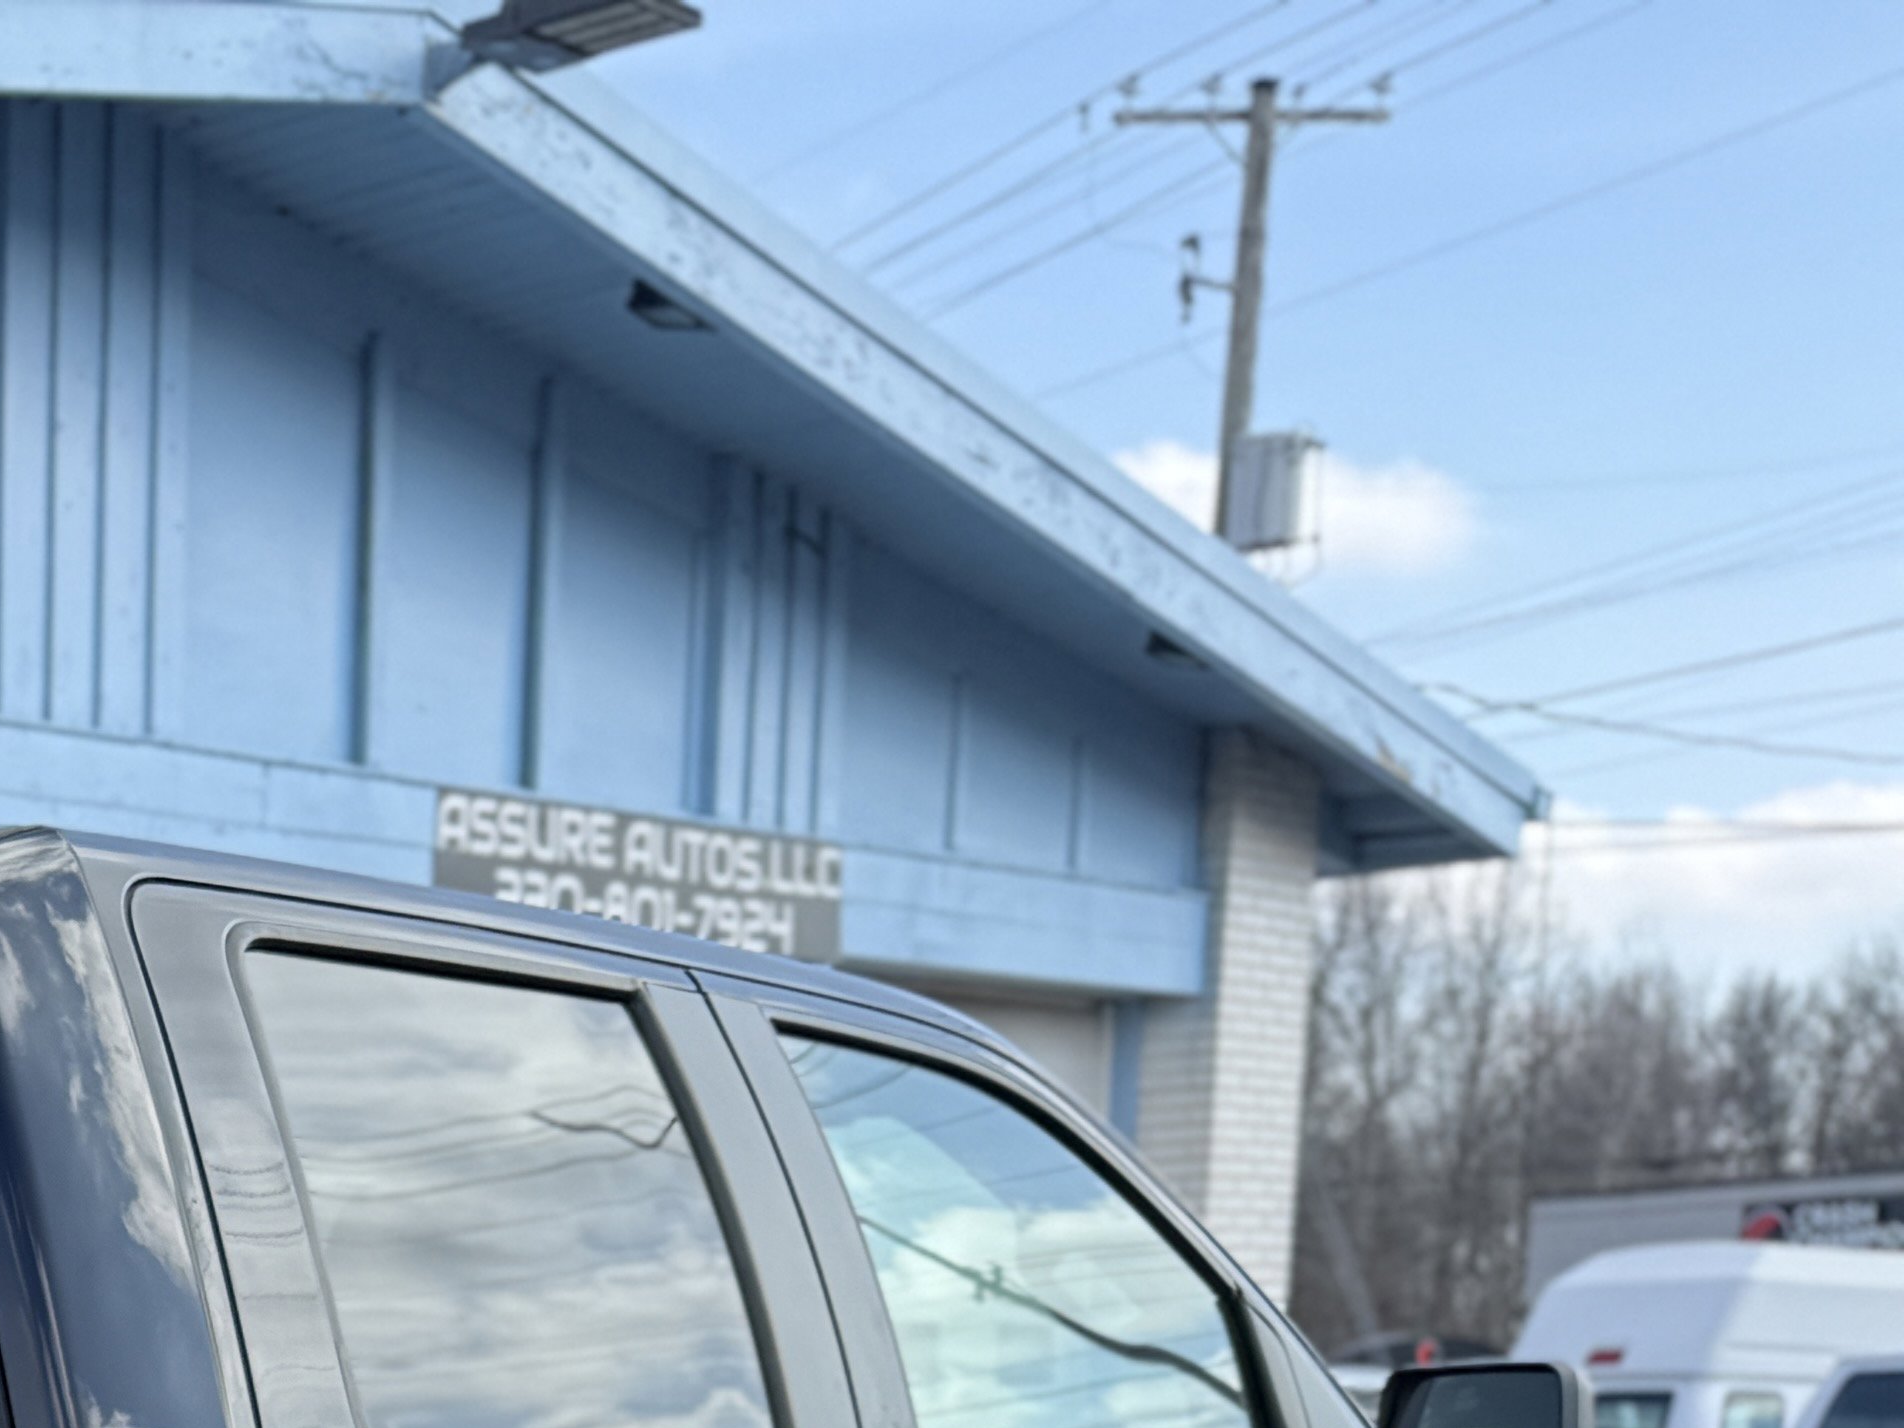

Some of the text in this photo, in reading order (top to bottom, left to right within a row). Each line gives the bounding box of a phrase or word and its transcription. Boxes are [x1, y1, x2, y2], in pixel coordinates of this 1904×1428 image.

[438, 792, 845, 898] ASSURE AUTOS LLC
